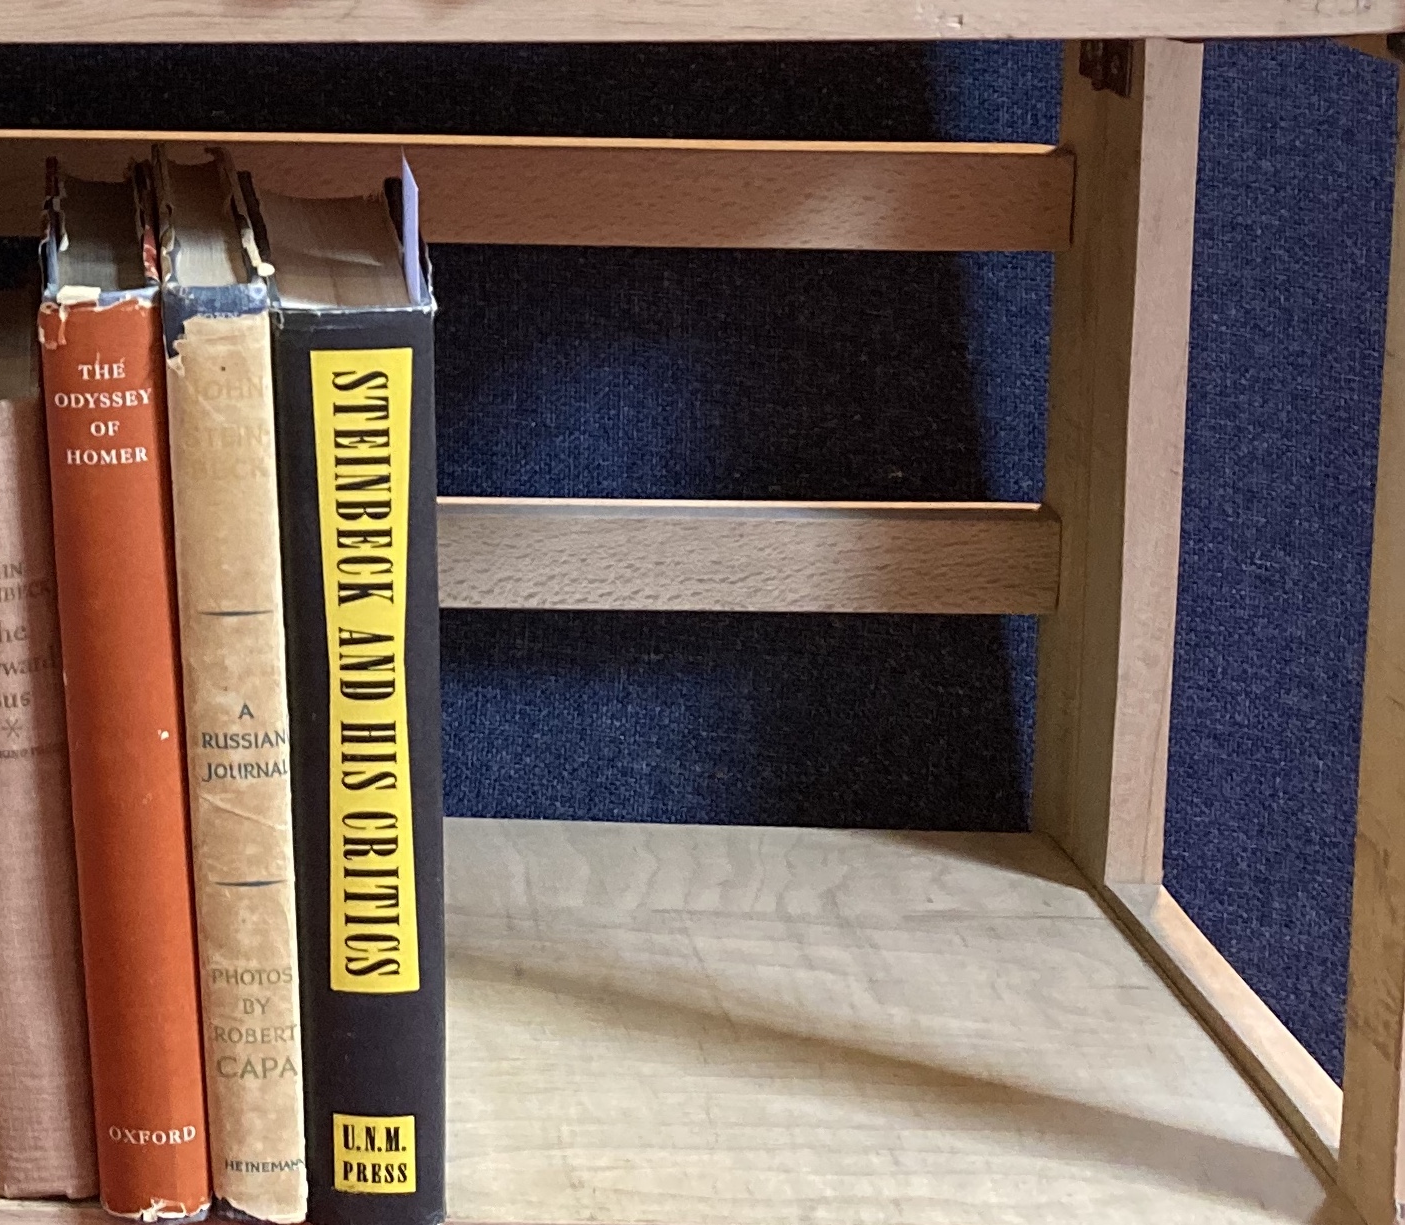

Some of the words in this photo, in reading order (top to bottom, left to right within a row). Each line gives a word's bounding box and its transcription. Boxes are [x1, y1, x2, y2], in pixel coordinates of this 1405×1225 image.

[78, 362, 126, 382] THE
[54, 387, 153, 409] ODYSSEY
[90, 420, 120, 437] OF
[66, 446, 149, 466] HOMER
[331, 369, 396, 607] STEINBECK
[337, 625, 396, 702] AND
[237, 702, 255, 719] A
[201, 729, 287, 750] RUSSIAN
[340, 719, 399, 792] HIS
[340, 809, 402, 977] CRITICS
[211, 967, 293, 987] PHOTOS
[242, 997, 272, 1016] BY
[108, 1123, 196, 1145] OXFORD
[342, 1123, 408, 1153] U.N.M.
[342, 1162, 408, 1185] PRESS
